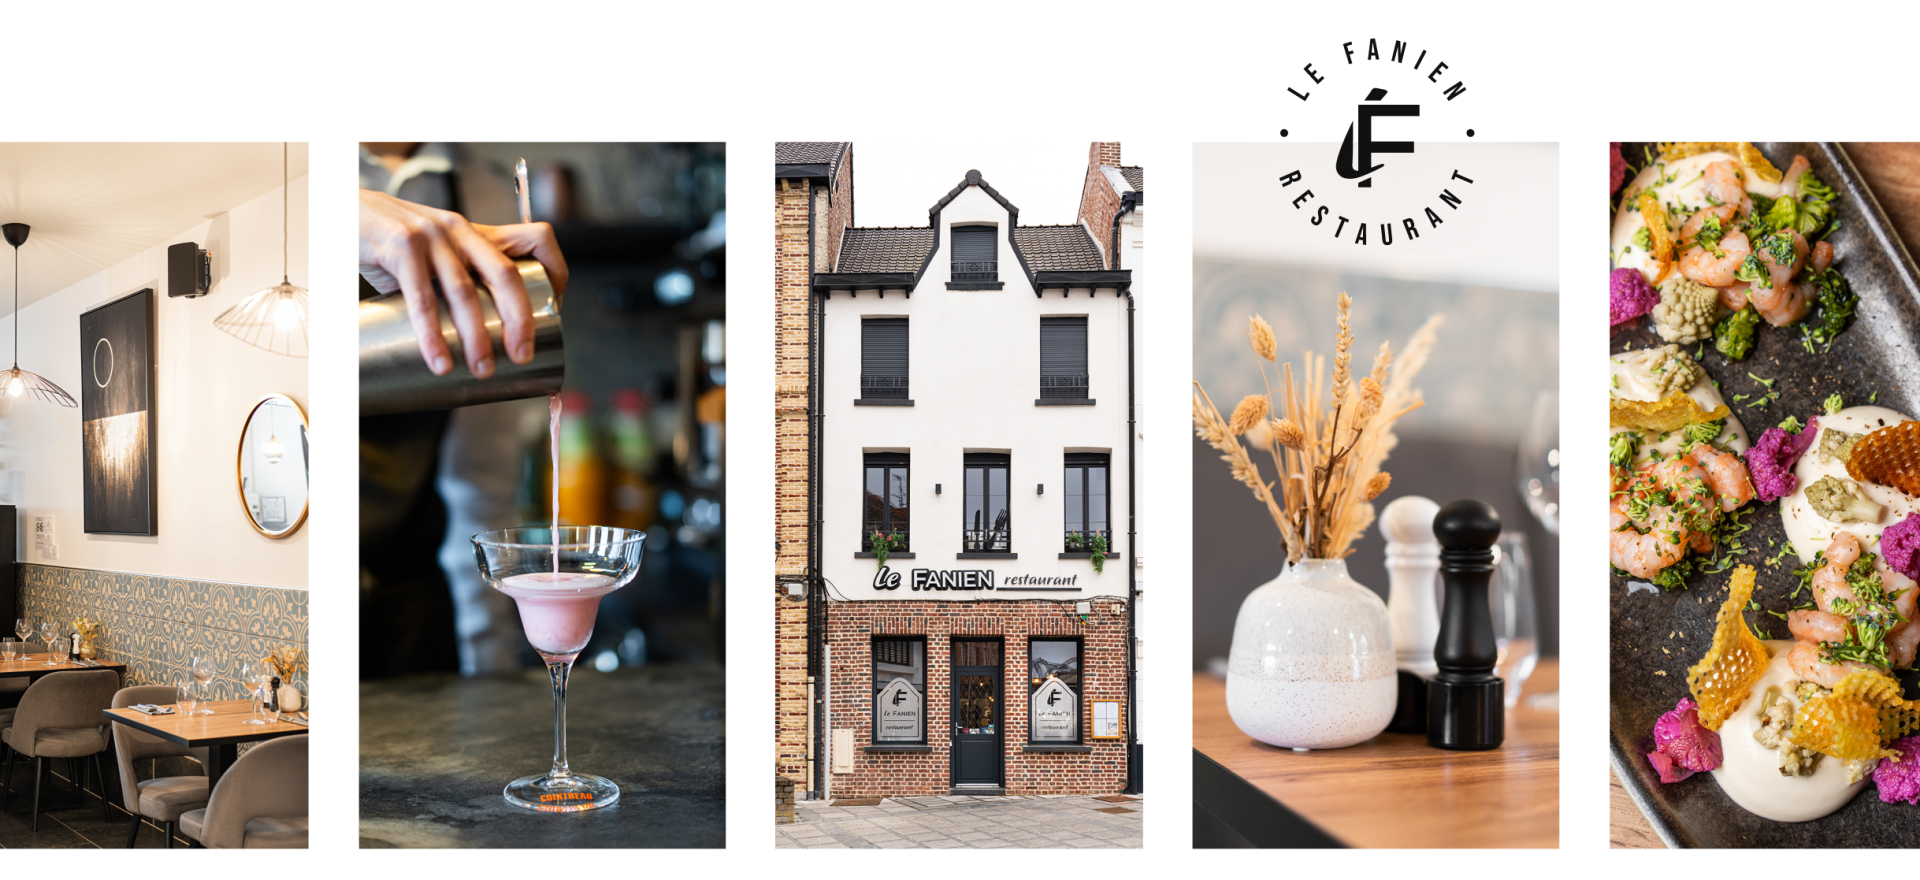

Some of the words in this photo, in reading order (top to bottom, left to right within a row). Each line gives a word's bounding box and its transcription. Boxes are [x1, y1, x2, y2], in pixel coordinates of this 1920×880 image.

[911, 569, 994, 591] FANIEN
[1004, 574, 1078, 586] restaurant
[540, 792, 592, 802] COINTREAU
